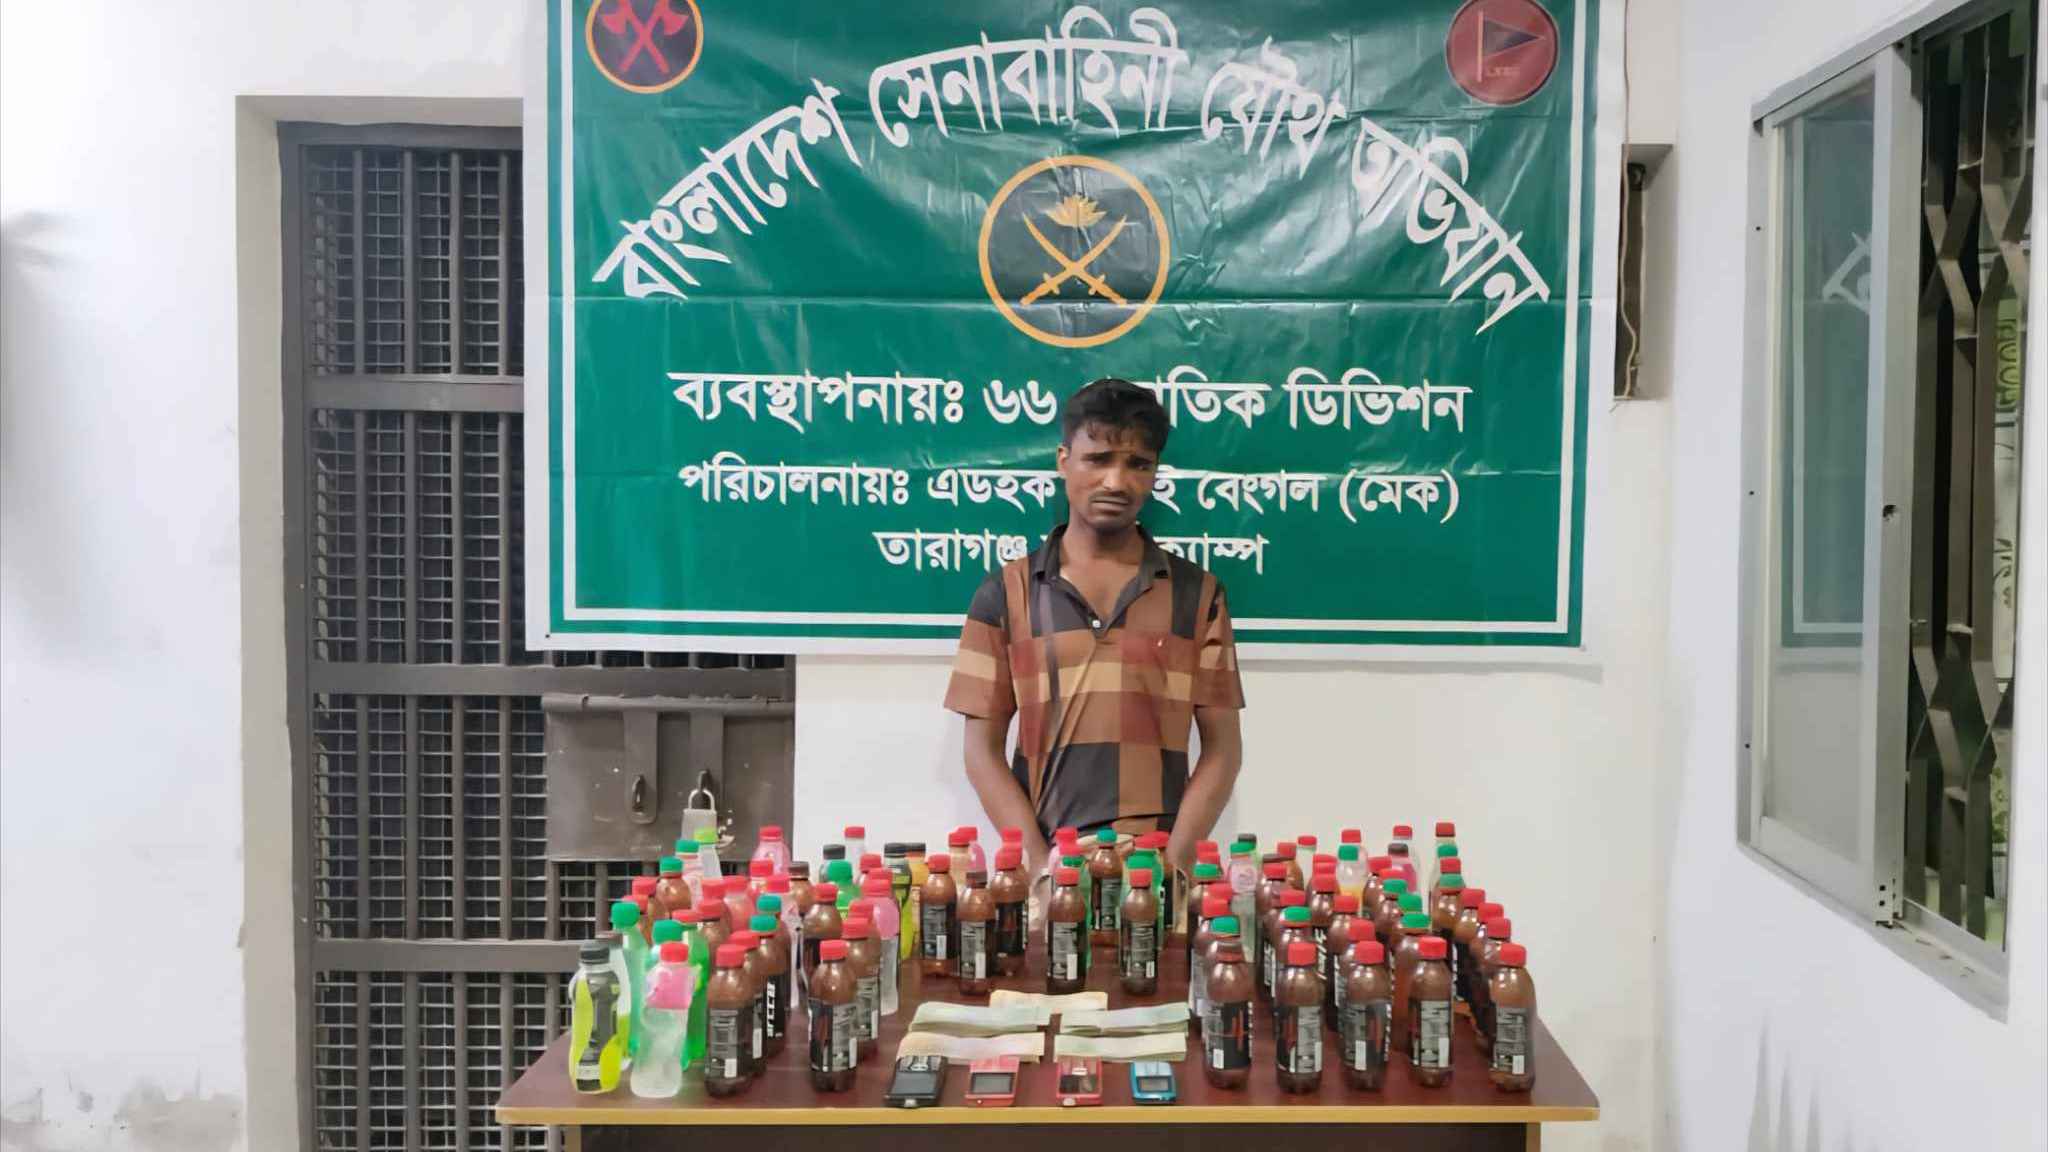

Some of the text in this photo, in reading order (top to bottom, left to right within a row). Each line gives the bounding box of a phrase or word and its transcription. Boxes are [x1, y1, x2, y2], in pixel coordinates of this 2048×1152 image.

[592, 78, 862, 299] বাংলাদেশ
[868, 5, 1190, 148] সেনাবাহিনী
[1351, 116, 1551, 336] অভিযান
[983, 379, 1058, 424] ৬৬
[1281, 366, 1473, 433] ডিভিশন
[927, 467, 1063, 514] এডহক
[1338, 468, 1460, 524] (মেক)
